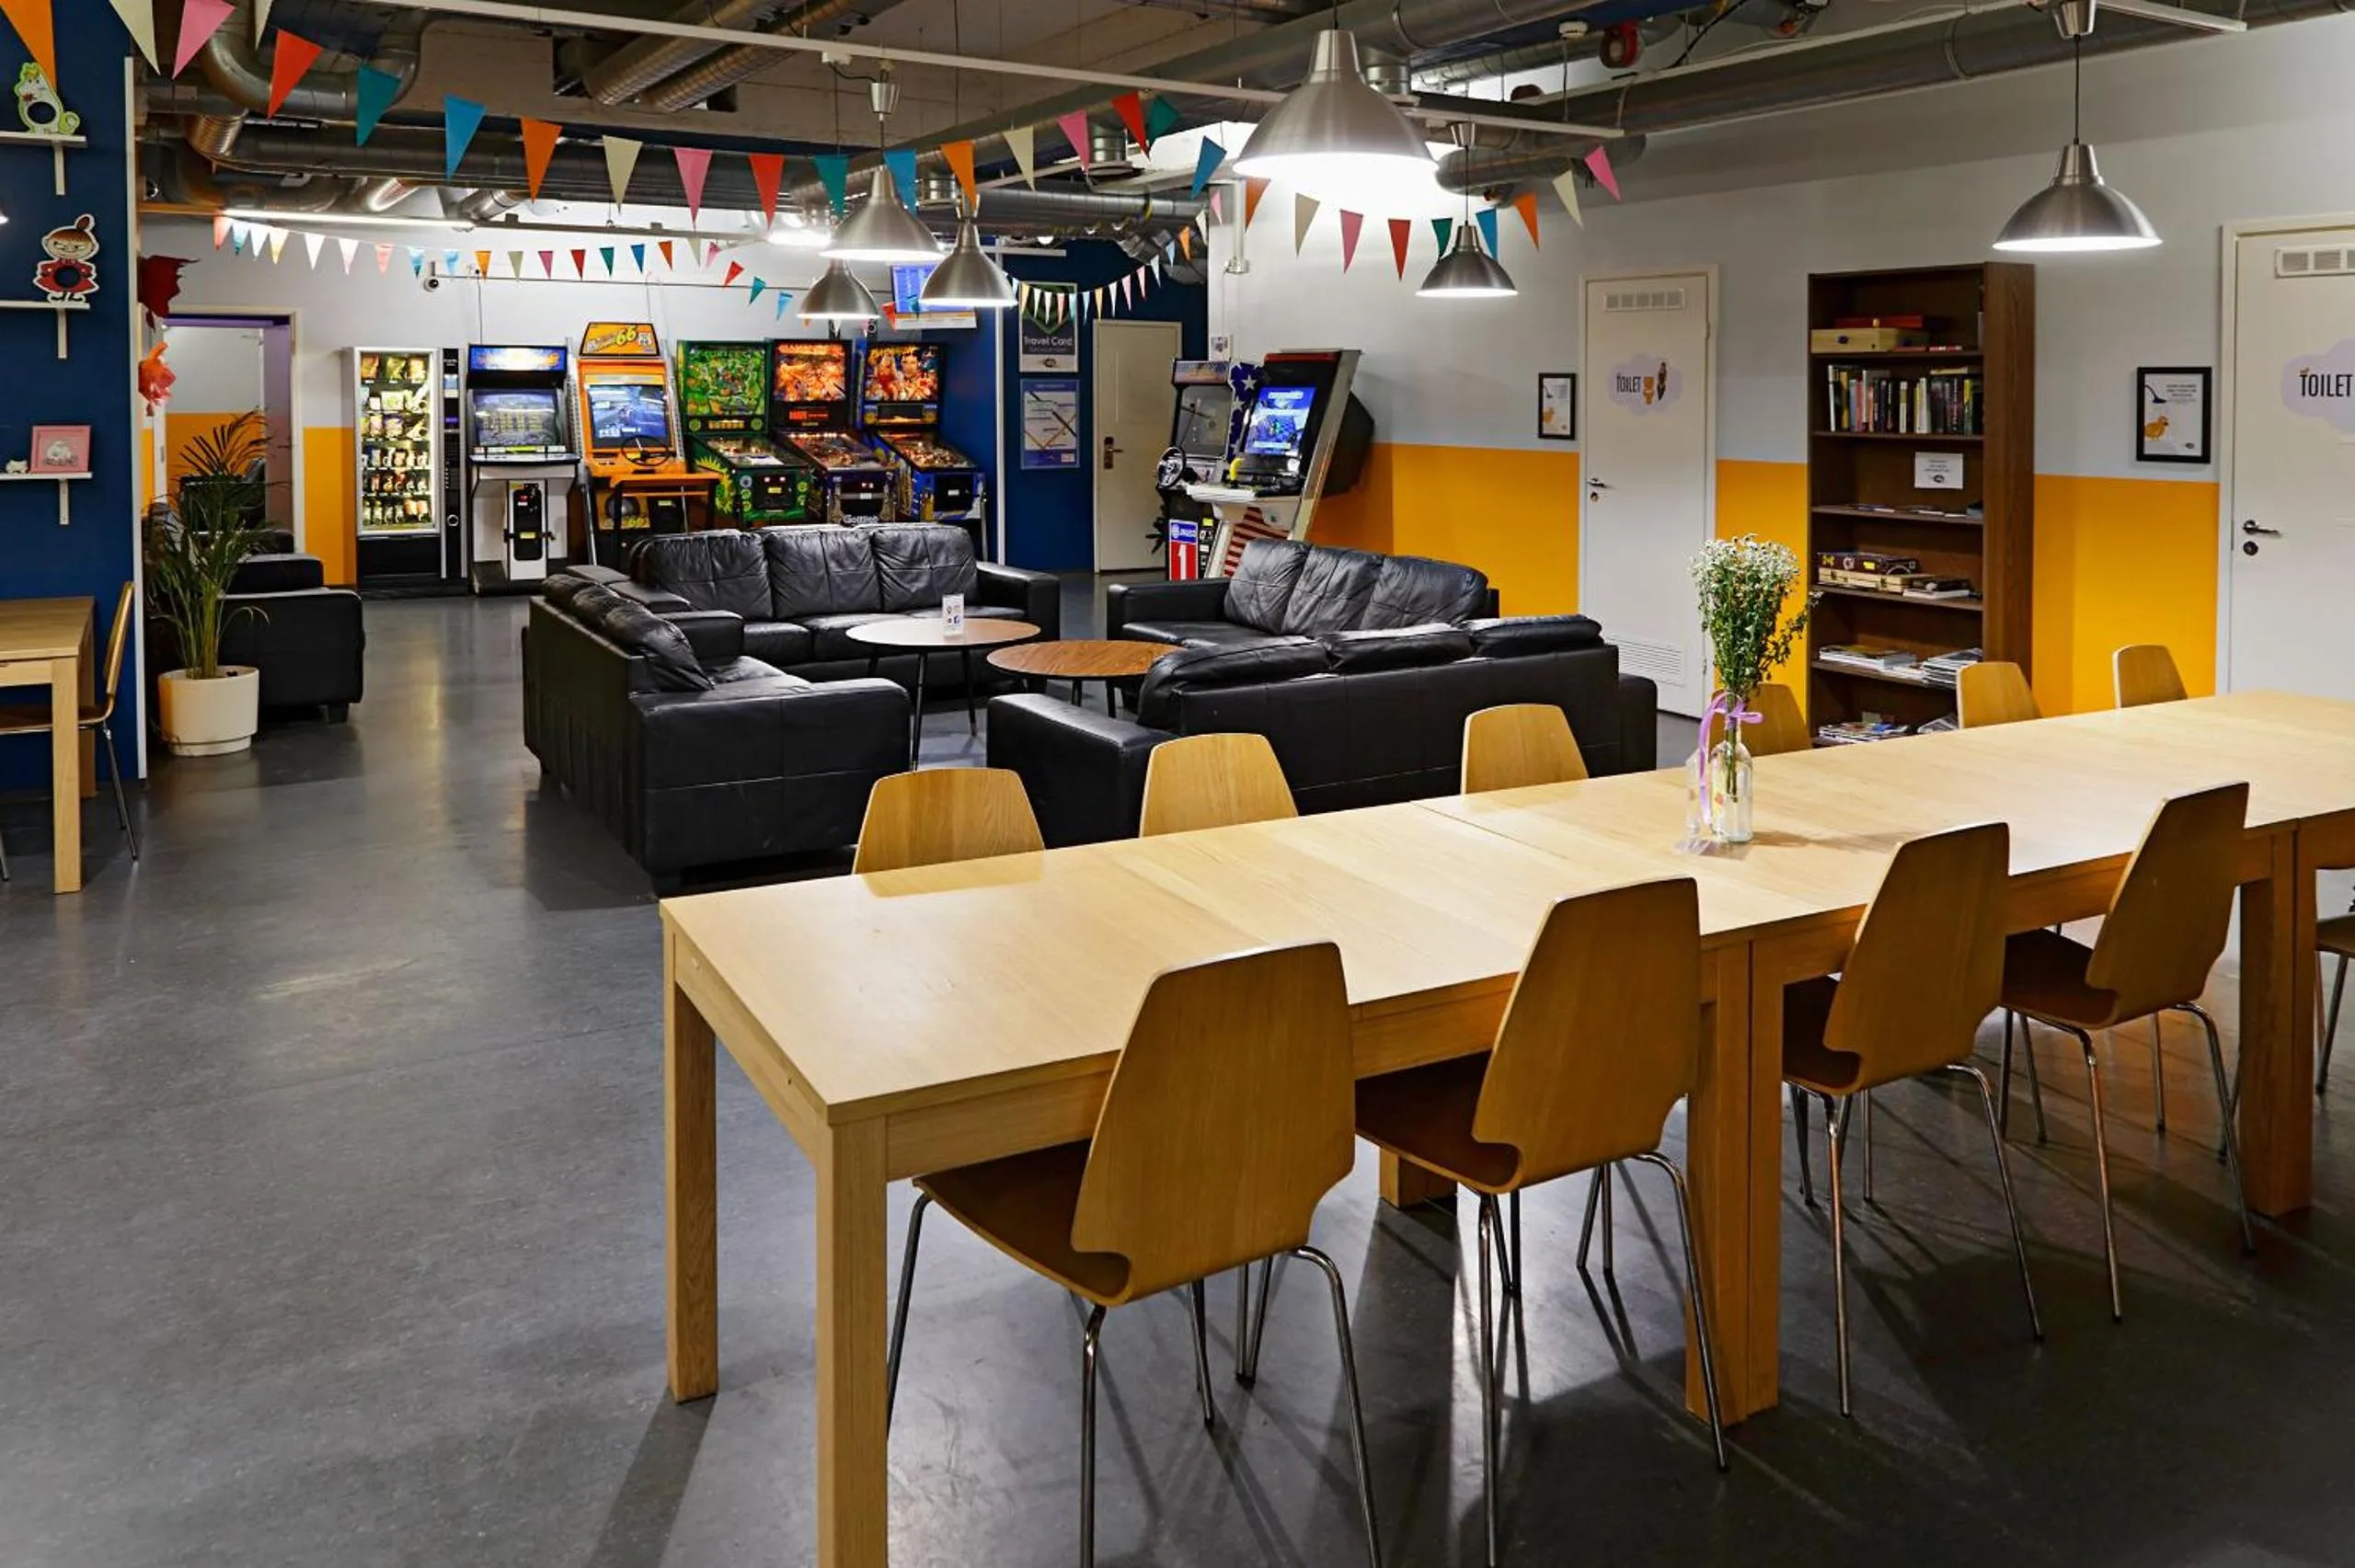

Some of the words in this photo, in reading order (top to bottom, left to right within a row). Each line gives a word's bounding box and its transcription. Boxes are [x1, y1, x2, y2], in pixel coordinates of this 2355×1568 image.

[1023, 336, 1050, 347] Travel
[1051, 337, 1074, 347] Card
[1616, 374, 1642, 393] TOILET
[2299, 373, 2354, 397] TOILET
